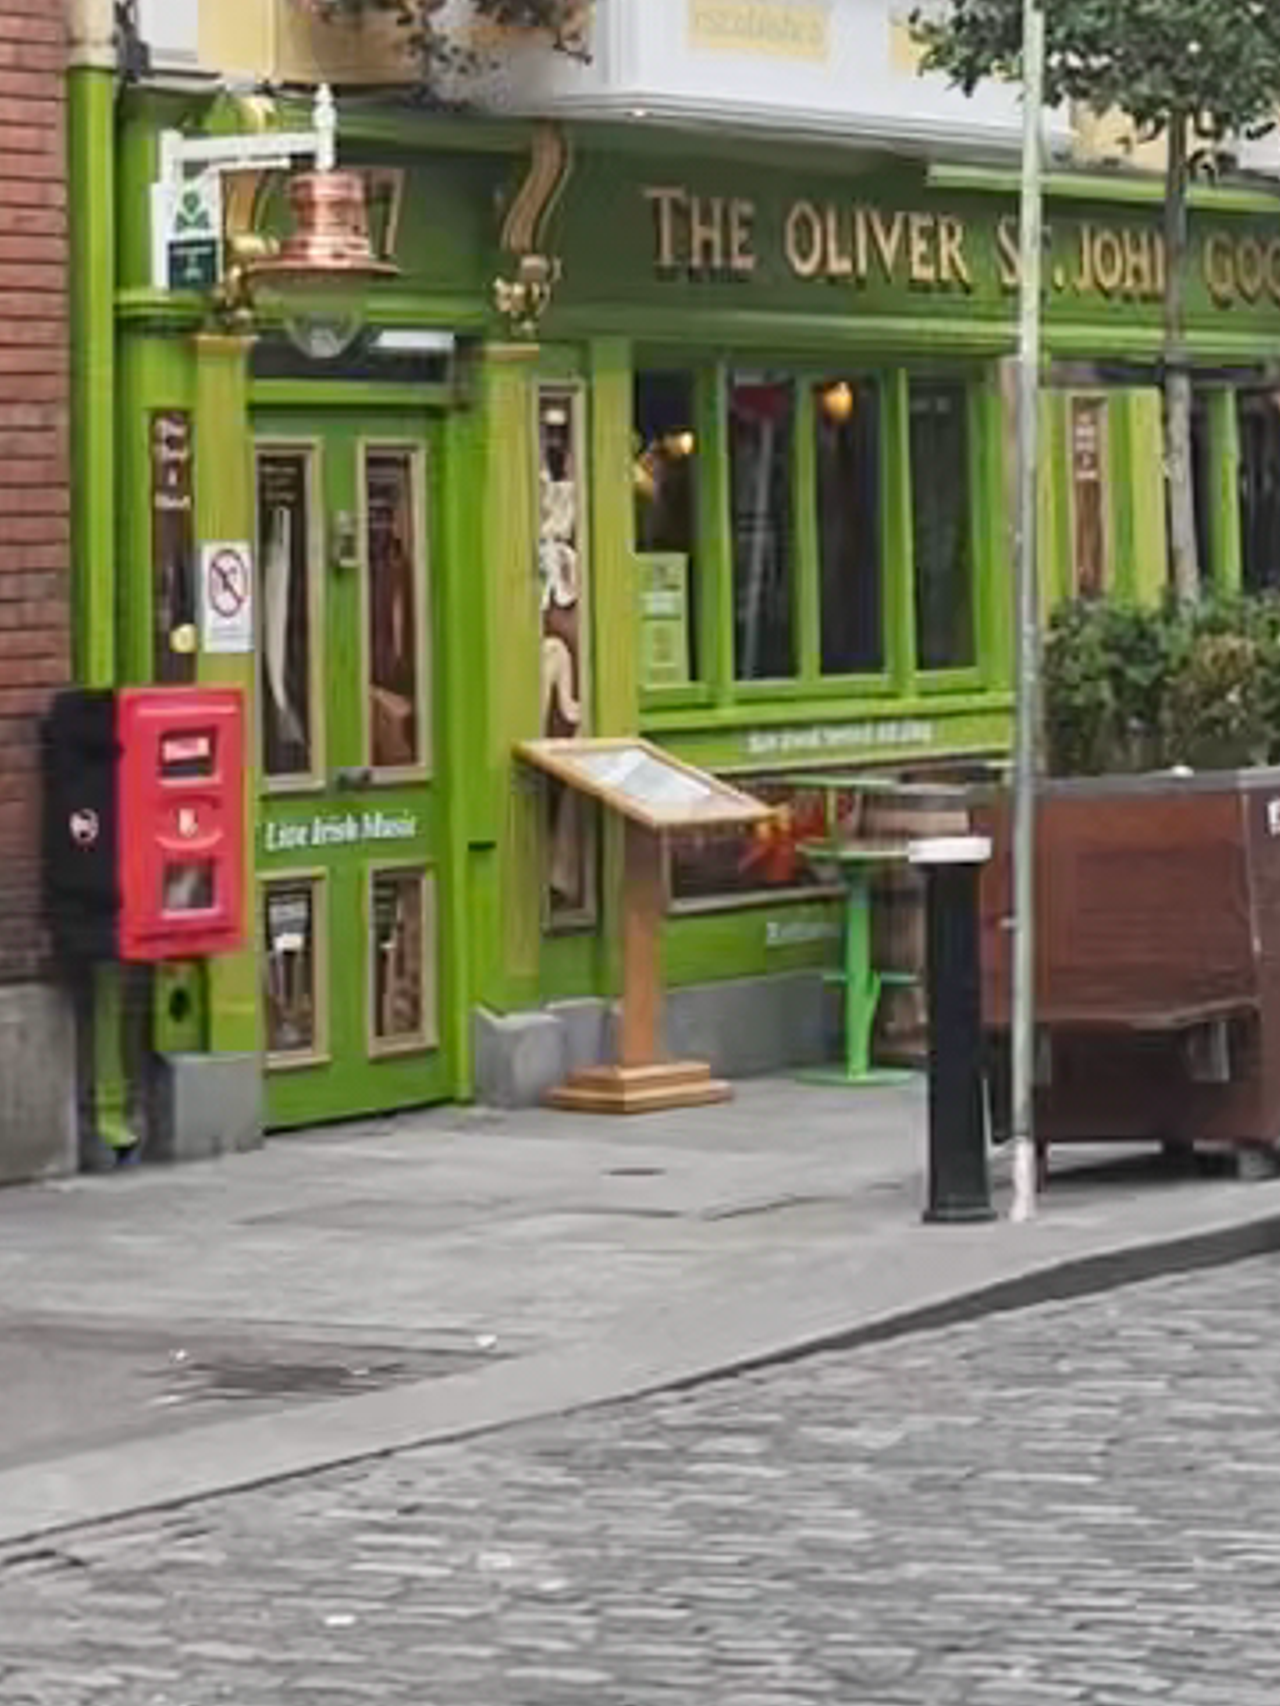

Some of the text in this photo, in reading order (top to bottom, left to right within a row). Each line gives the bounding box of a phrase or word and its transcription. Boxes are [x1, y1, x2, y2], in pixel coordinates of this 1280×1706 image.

[645, 184, 756, 276] THE
[783, 199, 972, 289] OLIVER
[265, 822, 308, 852] Live
[310, 811, 359, 847] Irish
